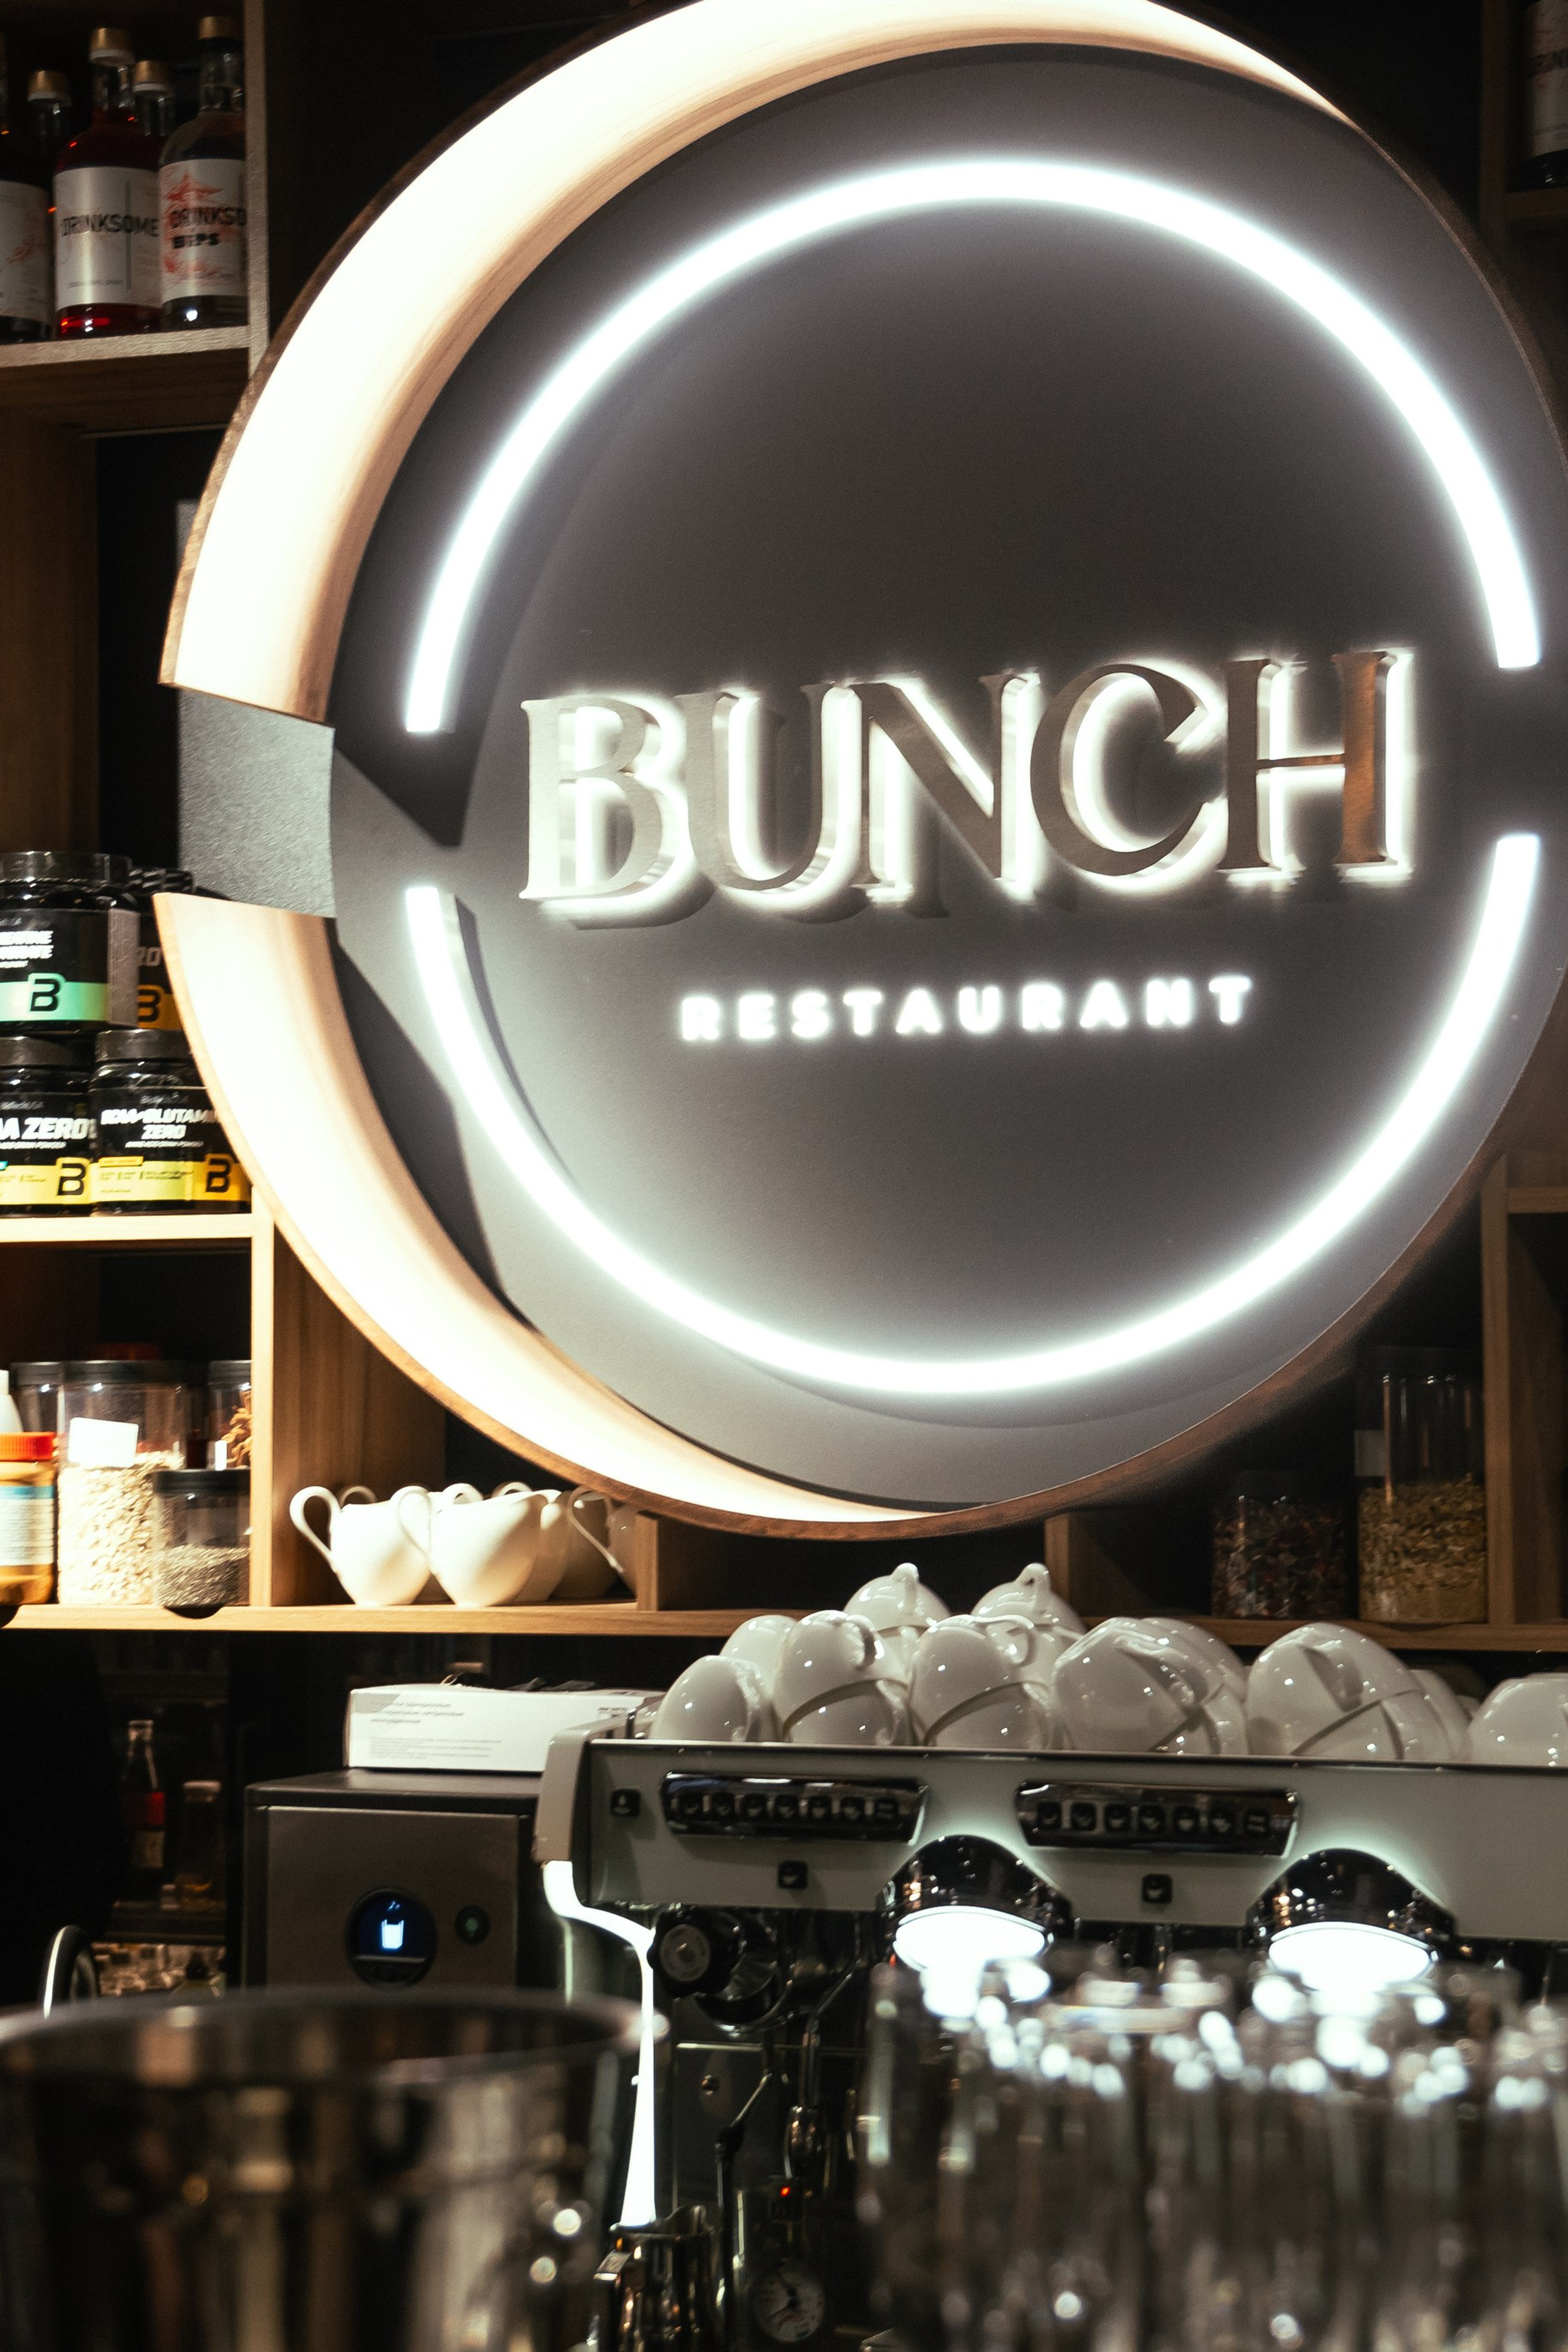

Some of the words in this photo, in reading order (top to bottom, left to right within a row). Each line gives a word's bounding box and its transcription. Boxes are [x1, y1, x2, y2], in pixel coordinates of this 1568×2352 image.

[519, 646, 1416, 919] BUNCH
[680, 975, 1253, 1042] RESTAURANT
[21, 1117, 89, 1139] ZERO
[141, 1125, 187, 1139] ZERO
[56, 1163, 86, 1196] B
